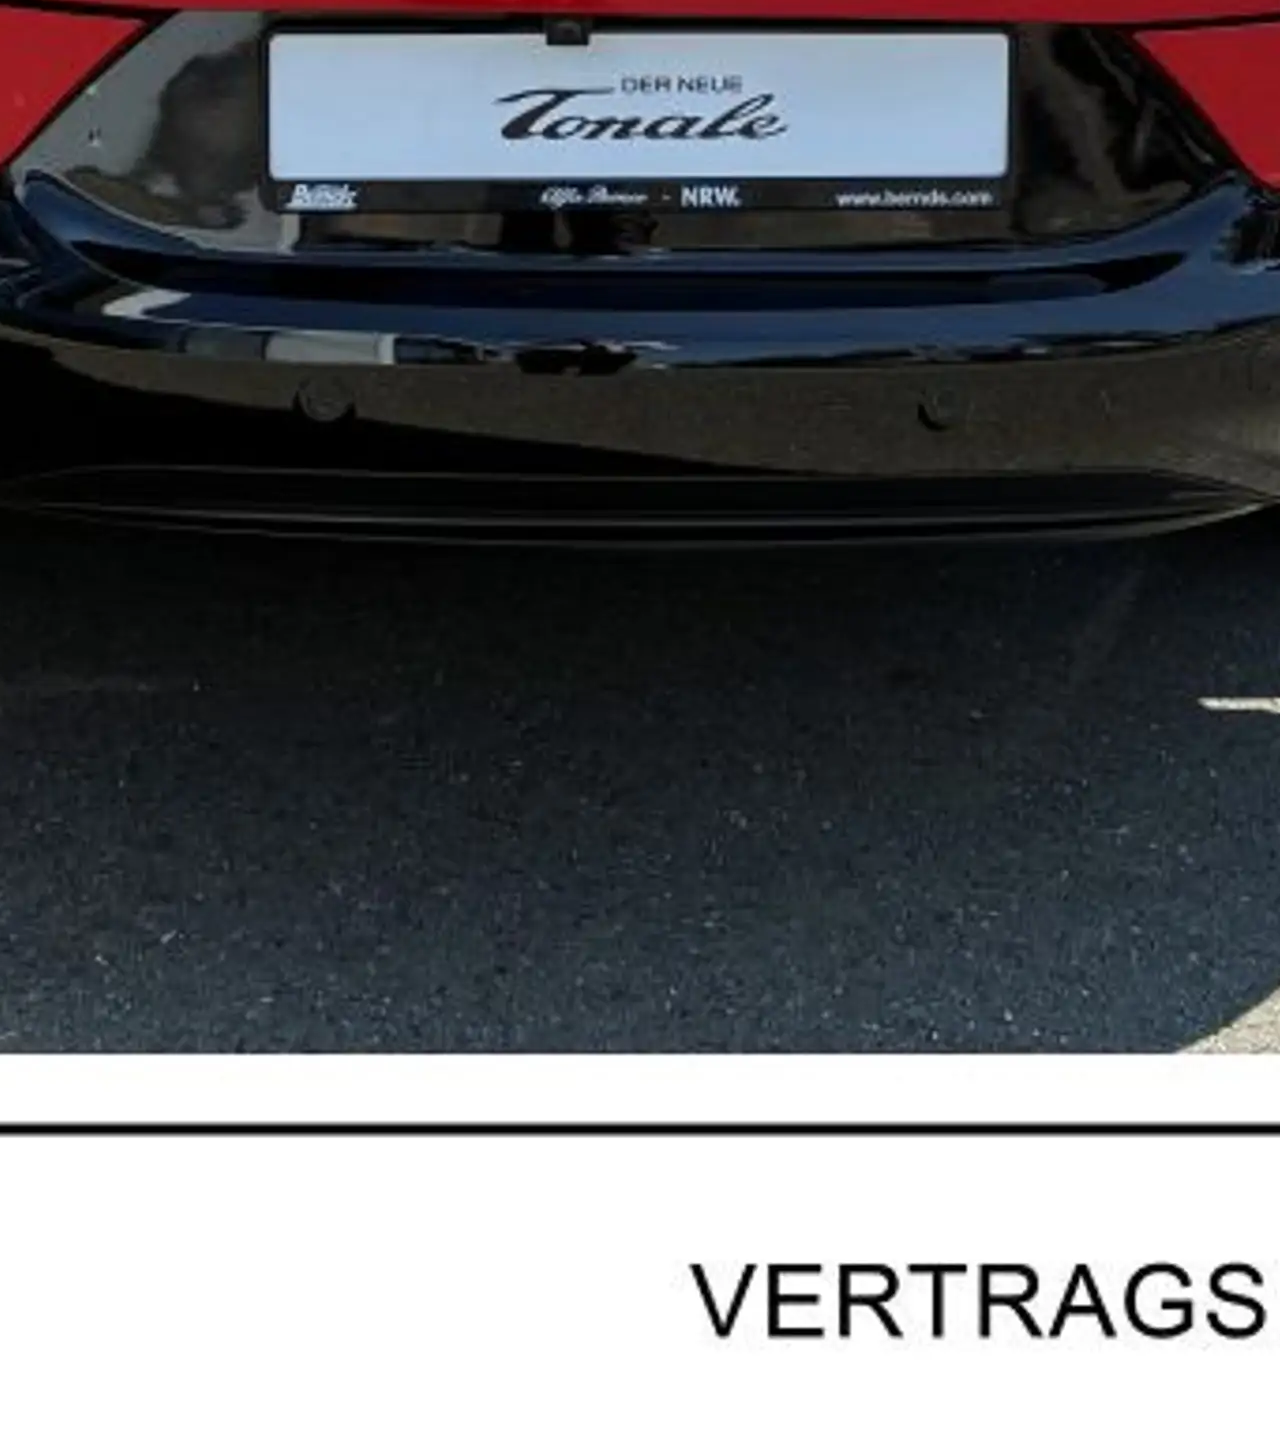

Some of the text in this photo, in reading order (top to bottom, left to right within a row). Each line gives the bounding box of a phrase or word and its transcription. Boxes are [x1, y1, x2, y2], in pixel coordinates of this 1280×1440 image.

[621, 76, 741, 93] DER NEUE
[493, 88, 788, 141] Tonale
